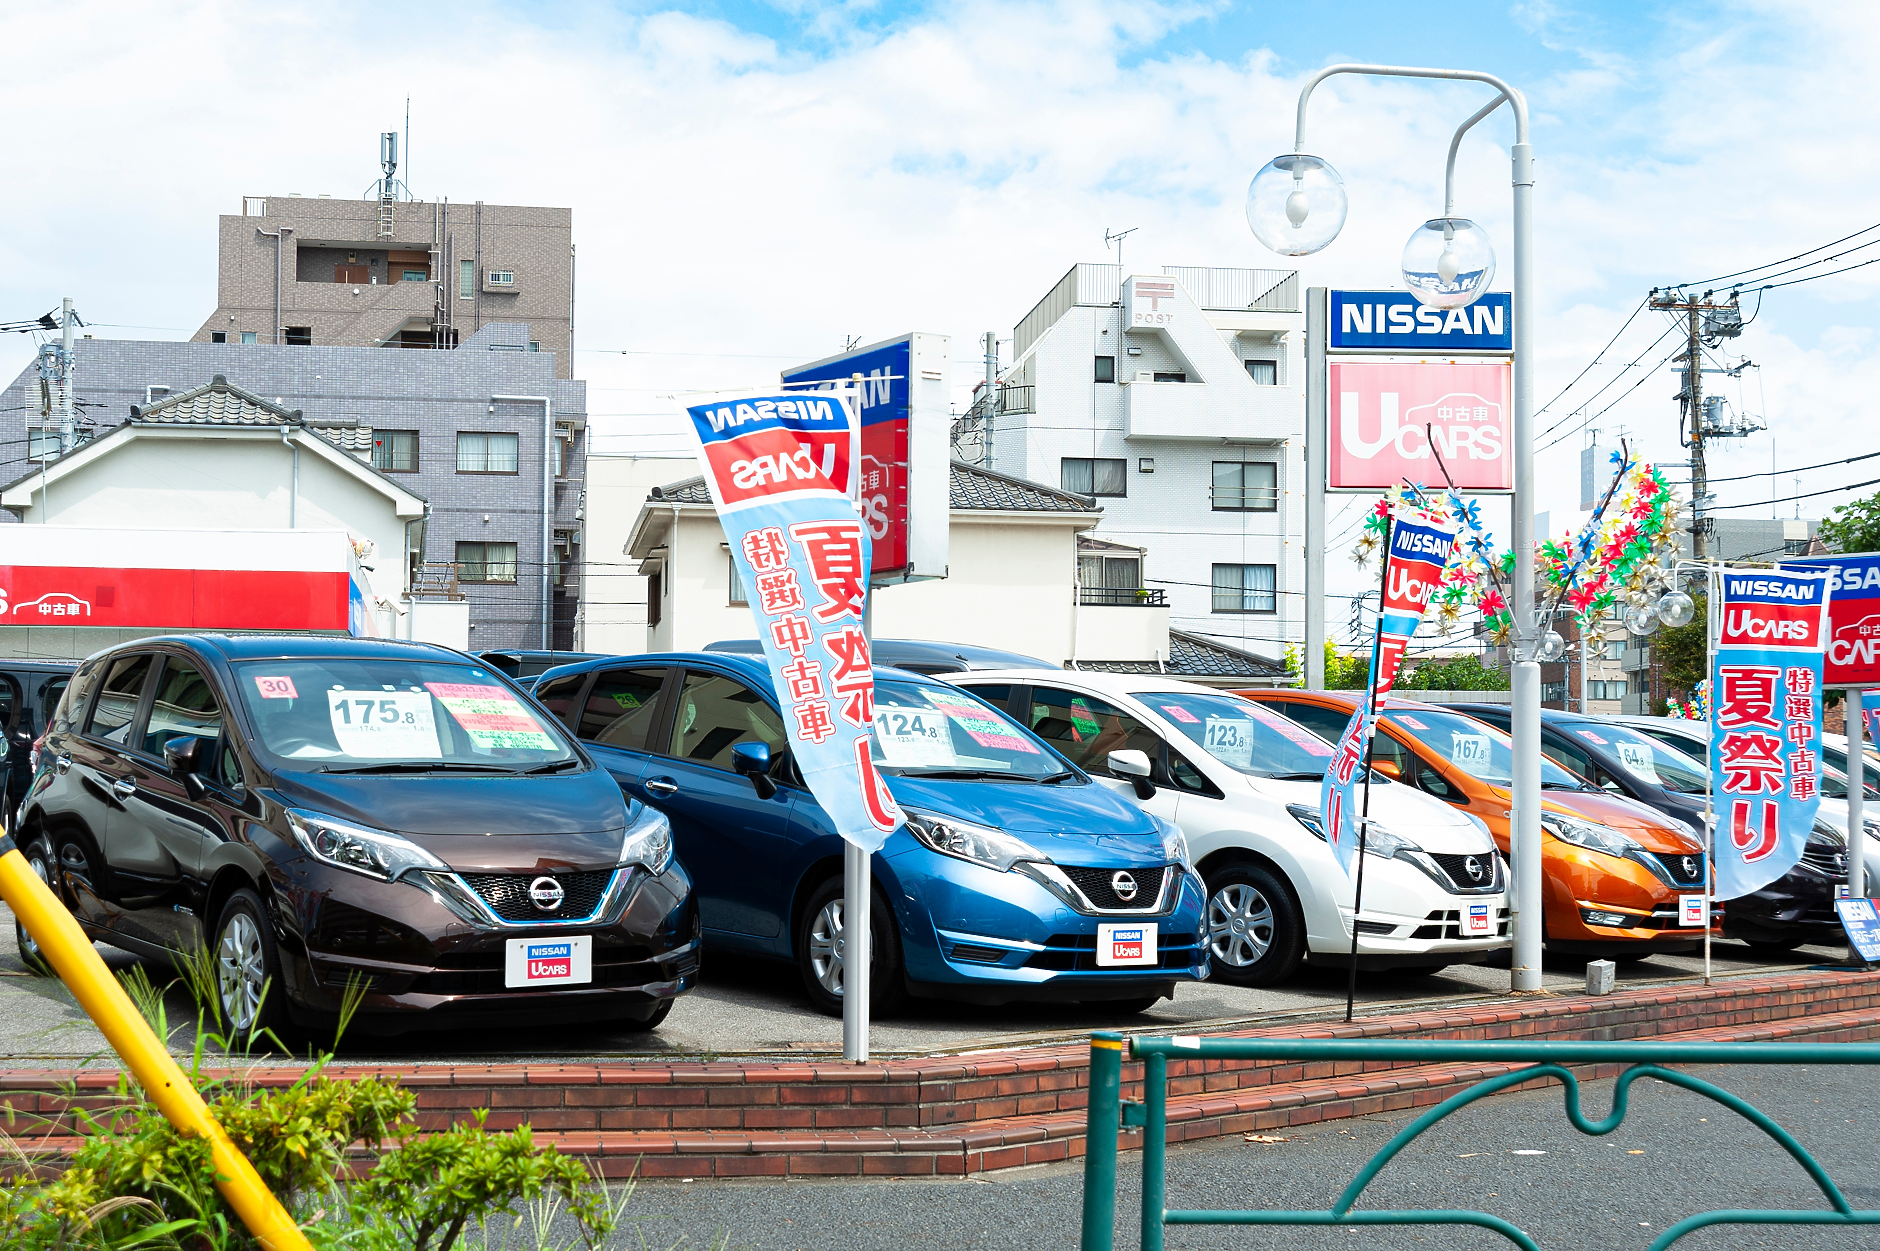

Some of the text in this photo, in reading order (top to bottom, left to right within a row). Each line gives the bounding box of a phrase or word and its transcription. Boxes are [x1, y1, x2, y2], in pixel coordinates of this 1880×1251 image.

[1135, 313, 1173, 323] POST
[1341, 303, 1504, 335] NISSAN
[1437, 406, 1489, 422] 中古車
[1396, 530, 1452, 559] NISSAN
[1730, 580, 1815, 600] NISSAN
[38, 602, 81, 616] 中古車
[1727, 609, 1809, 640] UCARS
[262, 680, 288, 693] 30
[334, 699, 415, 724] 175.8
[877, 713, 937, 739] 124.8
[1208, 724, 1245, 747] 123.8
[1784, 667, 1818, 801] 特選中古車
[1455, 739, 1485, 760] 167.8
[1717, 665, 1786, 864] 夏祭り
[531, 947, 567, 956] NISSAN
[531, 961, 567, 976] UCARS
